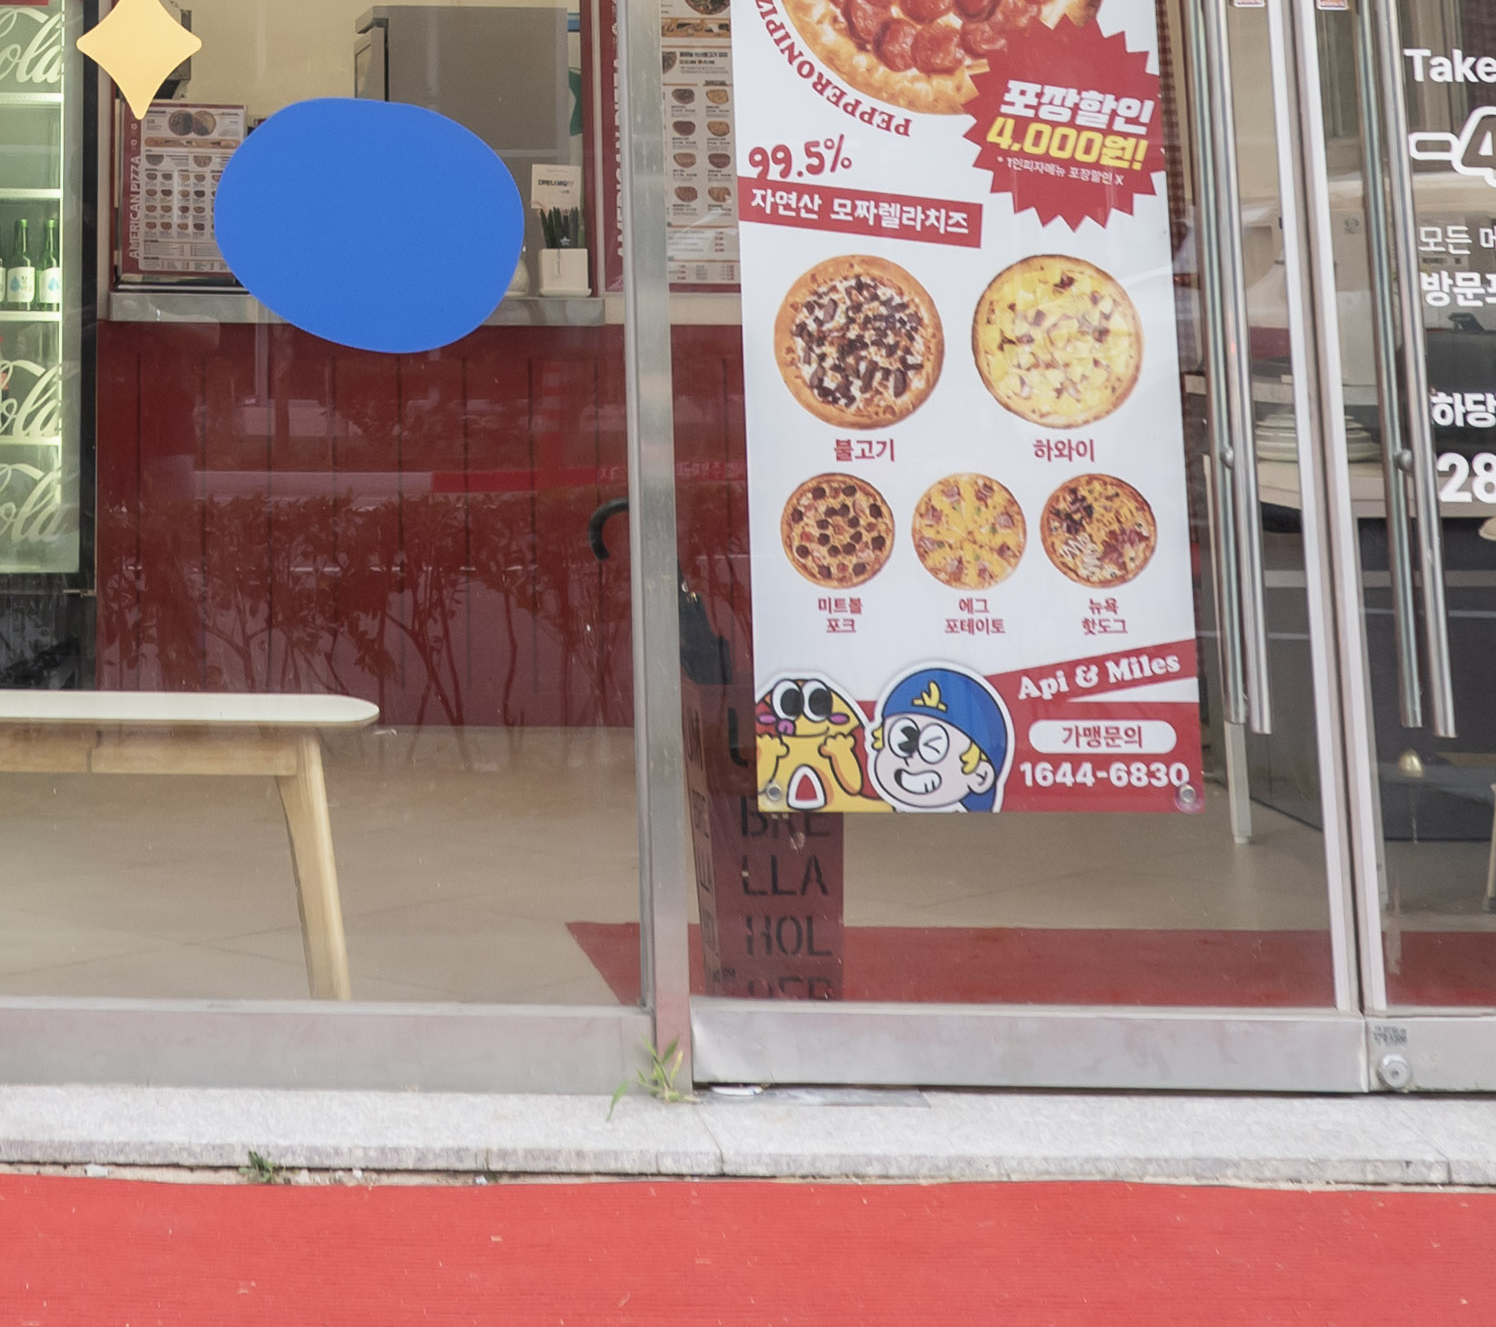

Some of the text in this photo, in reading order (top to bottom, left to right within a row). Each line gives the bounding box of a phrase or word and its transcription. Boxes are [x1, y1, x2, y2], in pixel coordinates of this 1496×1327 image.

[748, 133, 852, 180] 99.5%
[750, 188, 969, 235] 자연산 모짜렐라치즈
[1418, 226, 1472, 255] 모든
[834, 438, 1096, 463] 불고기 하와이
[817, 597, 863, 615] 미트볼
[959, 597, 990, 614] 에그
[826, 617, 1128, 635] 포크 포테이토 핫도그
[1018, 654, 1180, 700] Api & Miles
[1062, 725, 1142, 748] 가맹문의
[1020, 761, 1190, 788] 1644-6830
